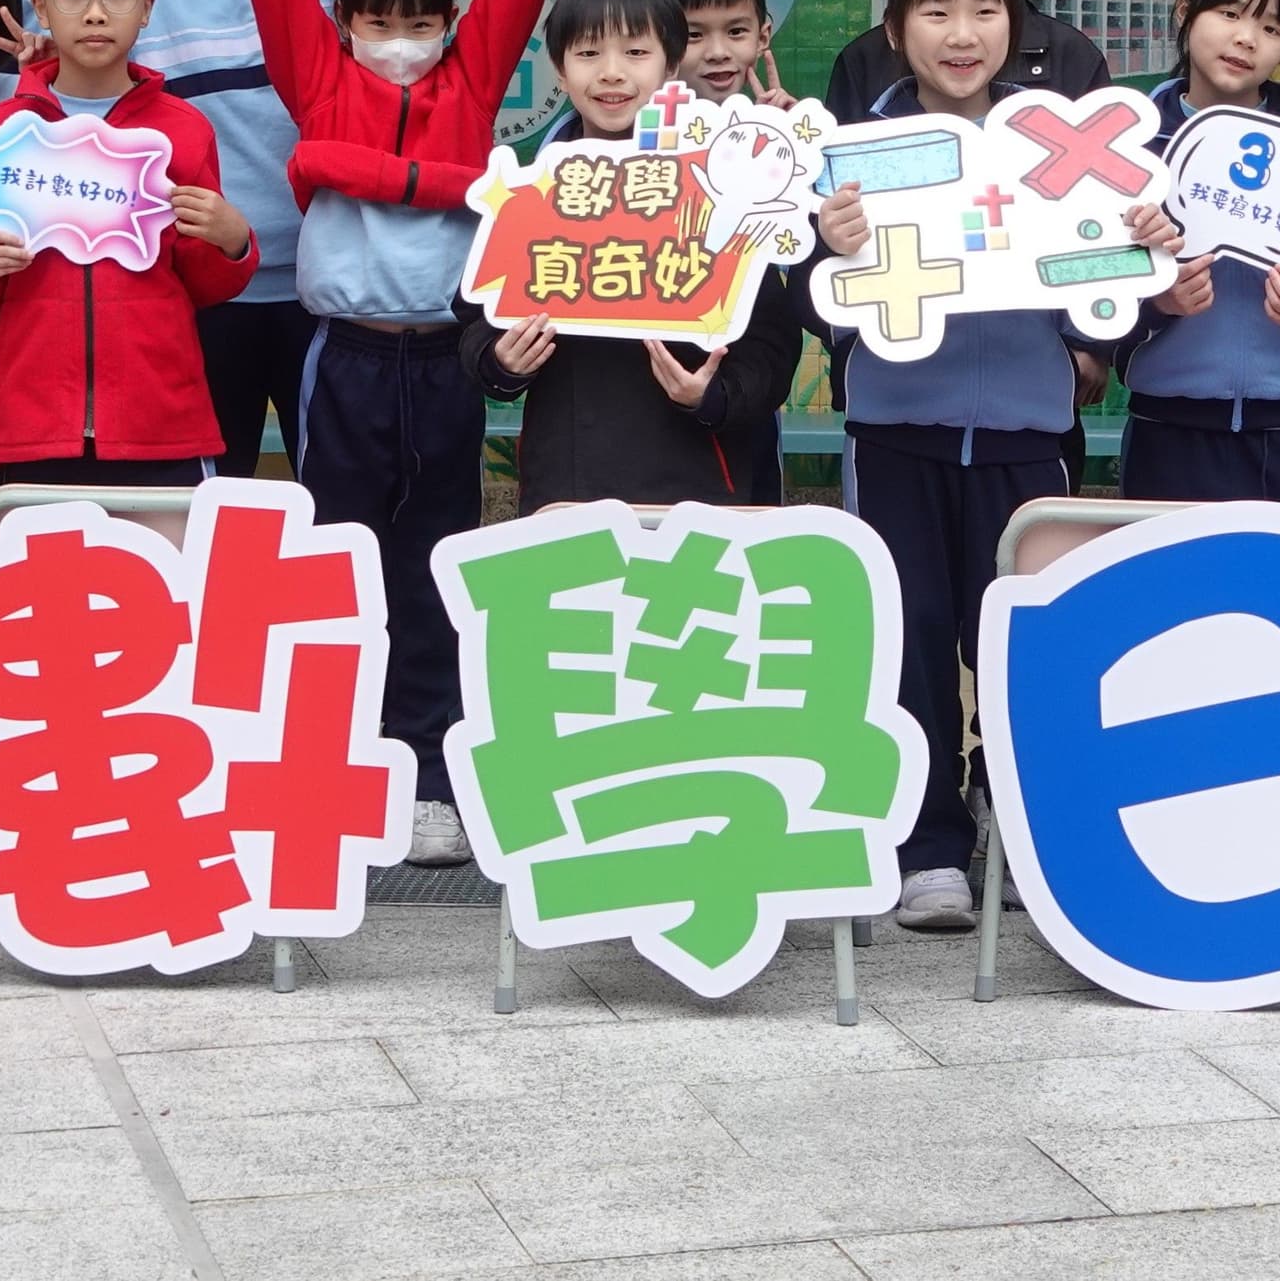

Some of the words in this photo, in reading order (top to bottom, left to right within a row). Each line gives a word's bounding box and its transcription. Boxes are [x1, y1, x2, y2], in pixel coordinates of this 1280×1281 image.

[553, 153, 680, 220] 數學
[1228, 131, 1276, 192] 3
[528, 236, 714, 305] 真奇妙
